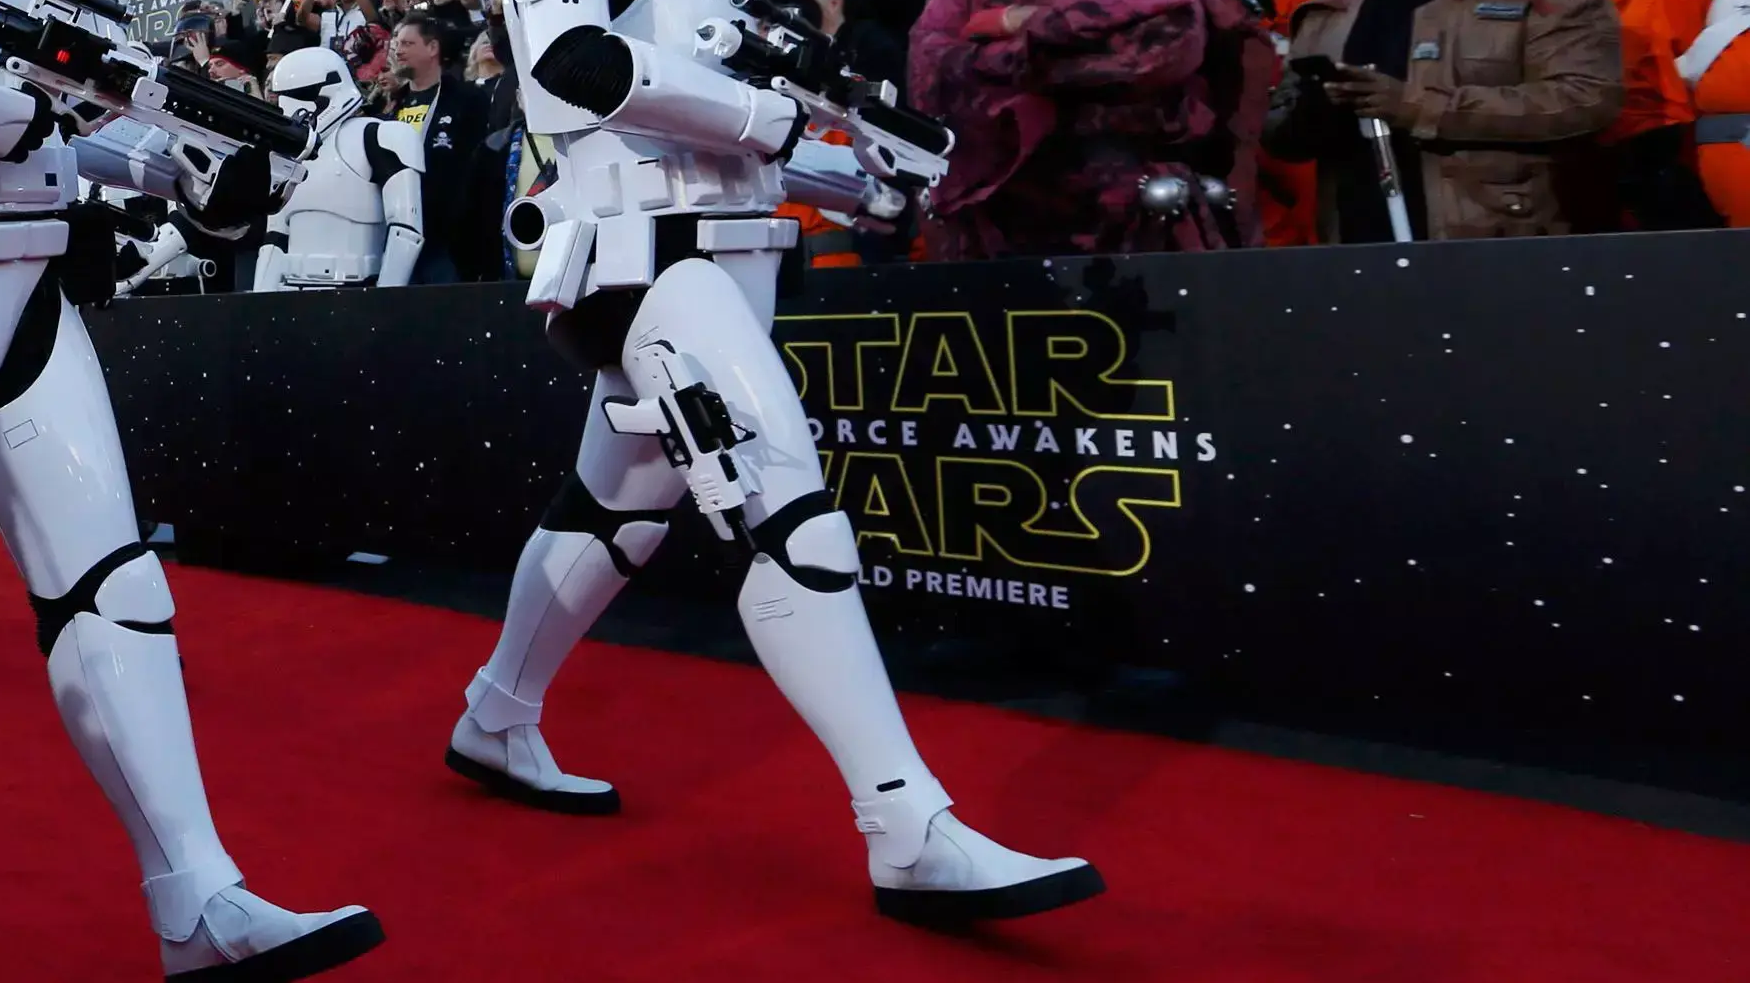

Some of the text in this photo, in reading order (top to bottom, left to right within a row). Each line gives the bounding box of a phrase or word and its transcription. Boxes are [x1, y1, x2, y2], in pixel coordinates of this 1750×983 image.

[953, 420, 1217, 463] AWAKENS
[817, 449, 1182, 576] ARS
[906, 568, 1070, 610] PREMIERE
